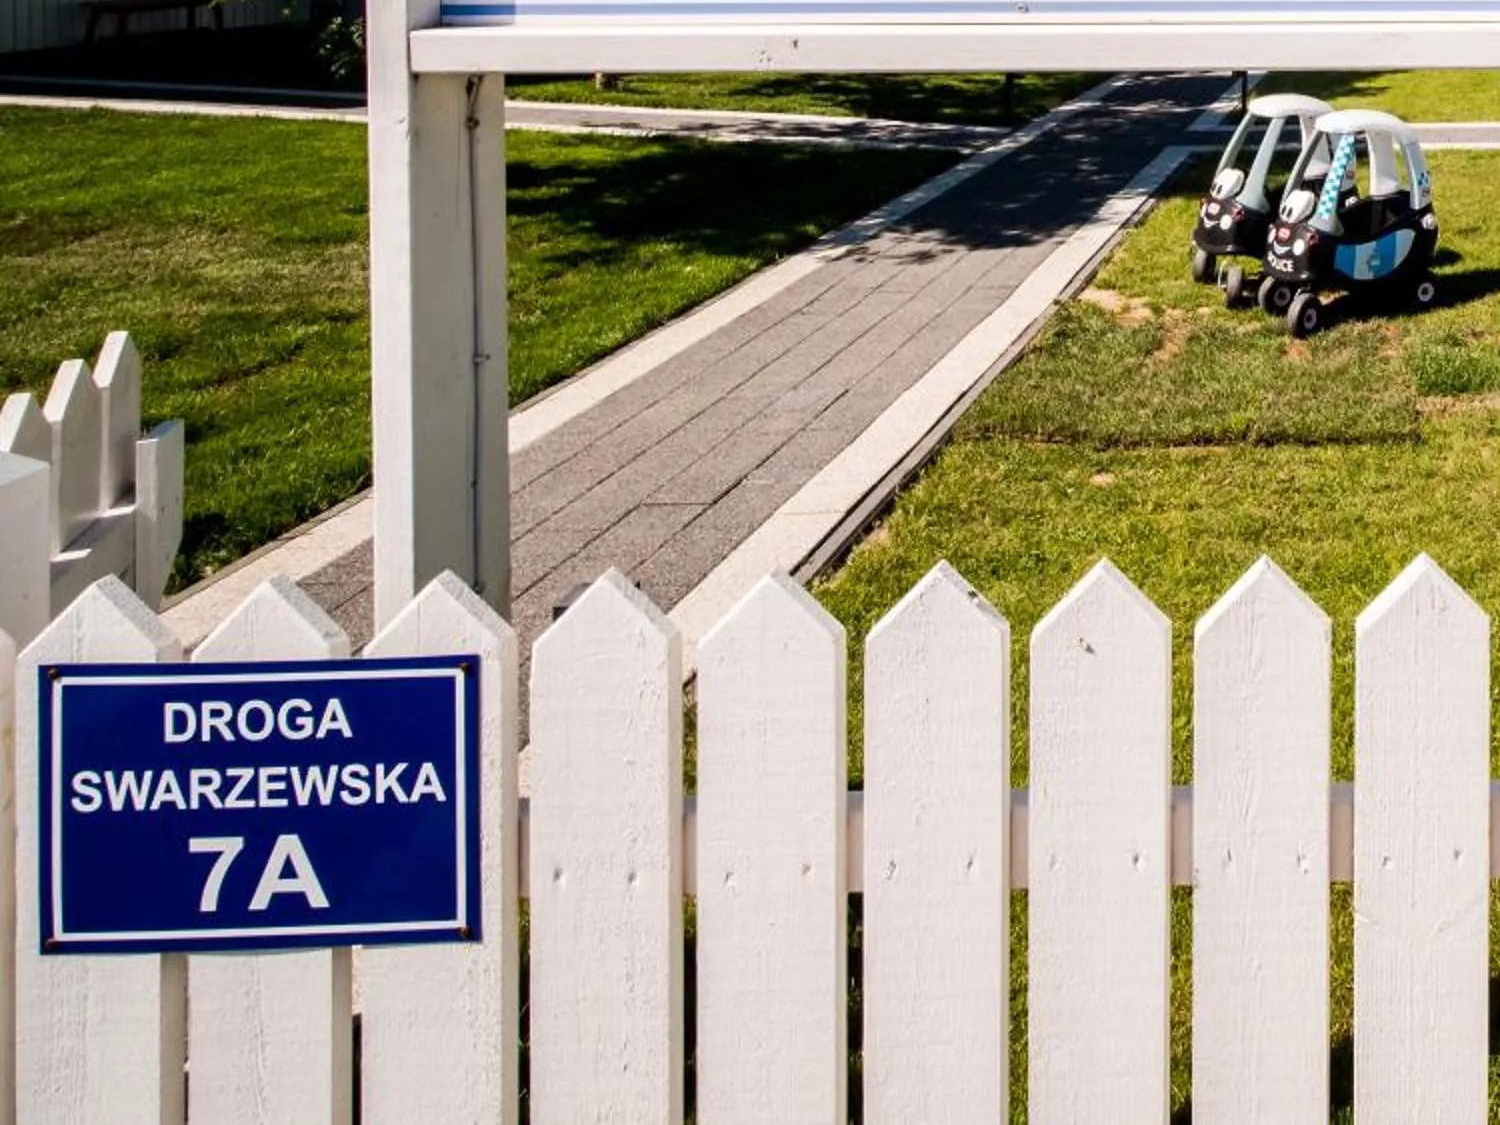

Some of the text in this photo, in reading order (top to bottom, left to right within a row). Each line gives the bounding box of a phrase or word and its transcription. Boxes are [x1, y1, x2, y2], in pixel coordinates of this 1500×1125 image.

[163, 698, 353, 743] DROGA
[71, 762, 447, 813] SWARZEWSKA
[188, 833, 330, 912] 7A
